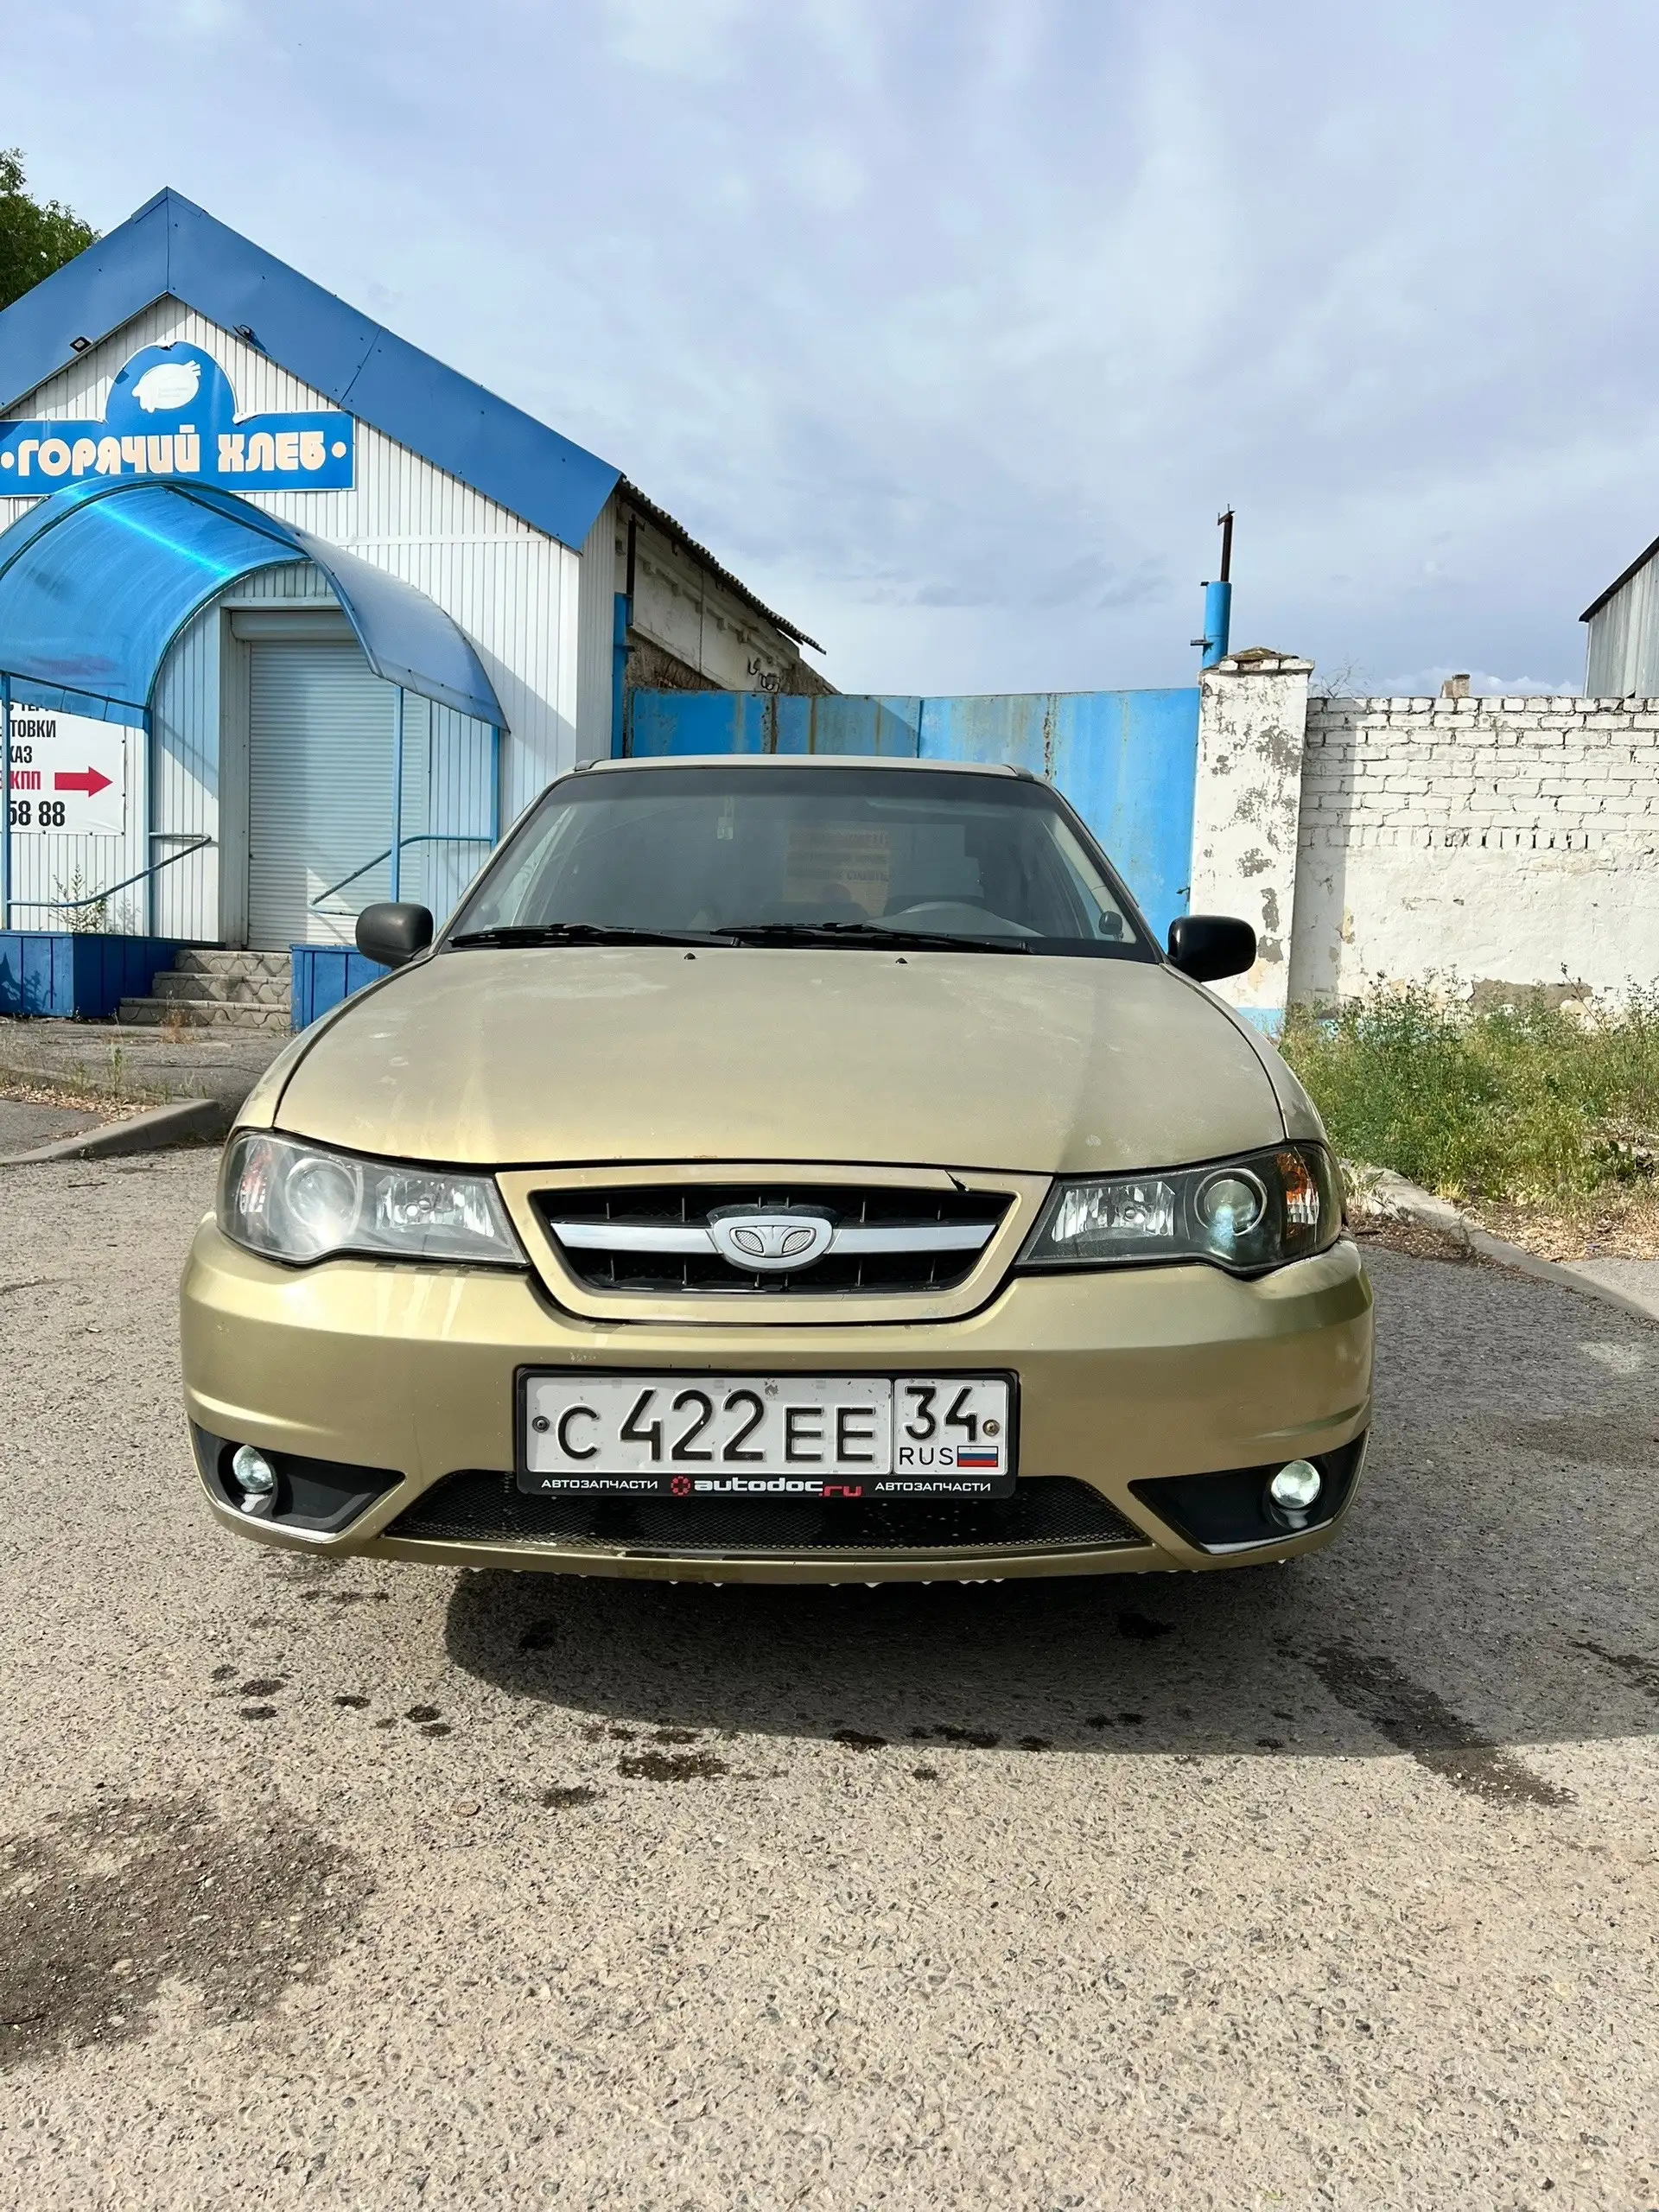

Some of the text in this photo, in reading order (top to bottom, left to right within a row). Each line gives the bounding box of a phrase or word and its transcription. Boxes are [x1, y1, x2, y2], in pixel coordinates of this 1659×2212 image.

[17, 424, 327, 476] ГОРЯЧИЙ ХЛЕБ
[10, 719, 56, 738] ТОВКИ
[38, 800, 66, 827] 88
[904, 1386, 977, 1441] 34
[899, 1446, 954, 1465] RUS
[541, 1477, 992, 1497] АВТОЗАПЧАСТИ autodoc.ru АВТОЗАПЧАСТИ
